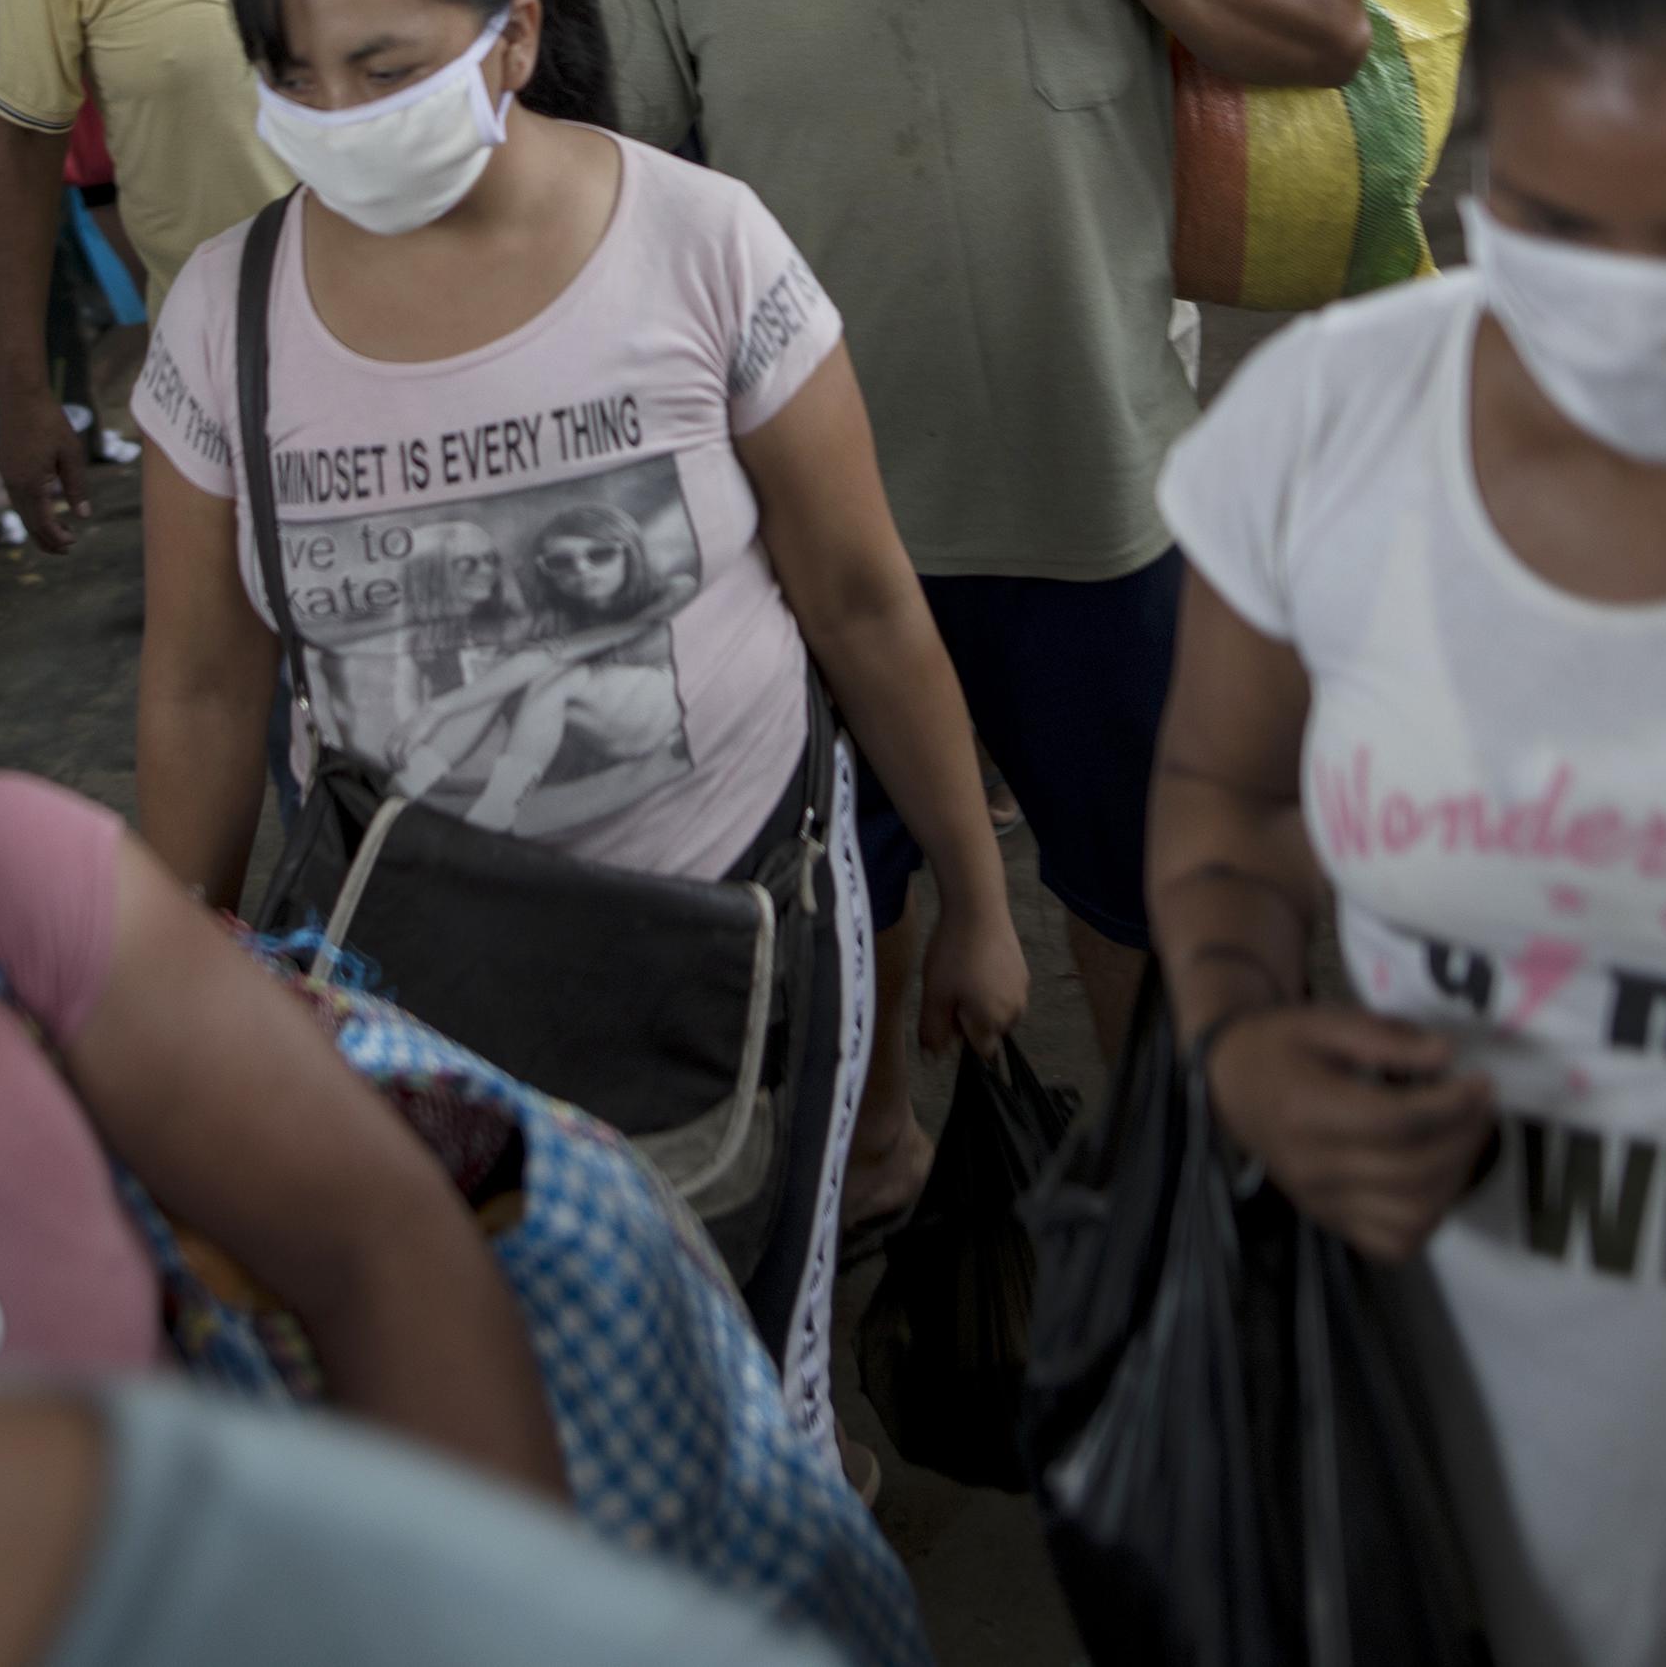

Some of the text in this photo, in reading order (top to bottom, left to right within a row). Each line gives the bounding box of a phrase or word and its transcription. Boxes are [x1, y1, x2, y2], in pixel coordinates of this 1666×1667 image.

[275, 394, 642, 505] MINDSET IS EVERY THING
[284, 524, 414, 571] ve to
[287, 576, 402, 619] kate
